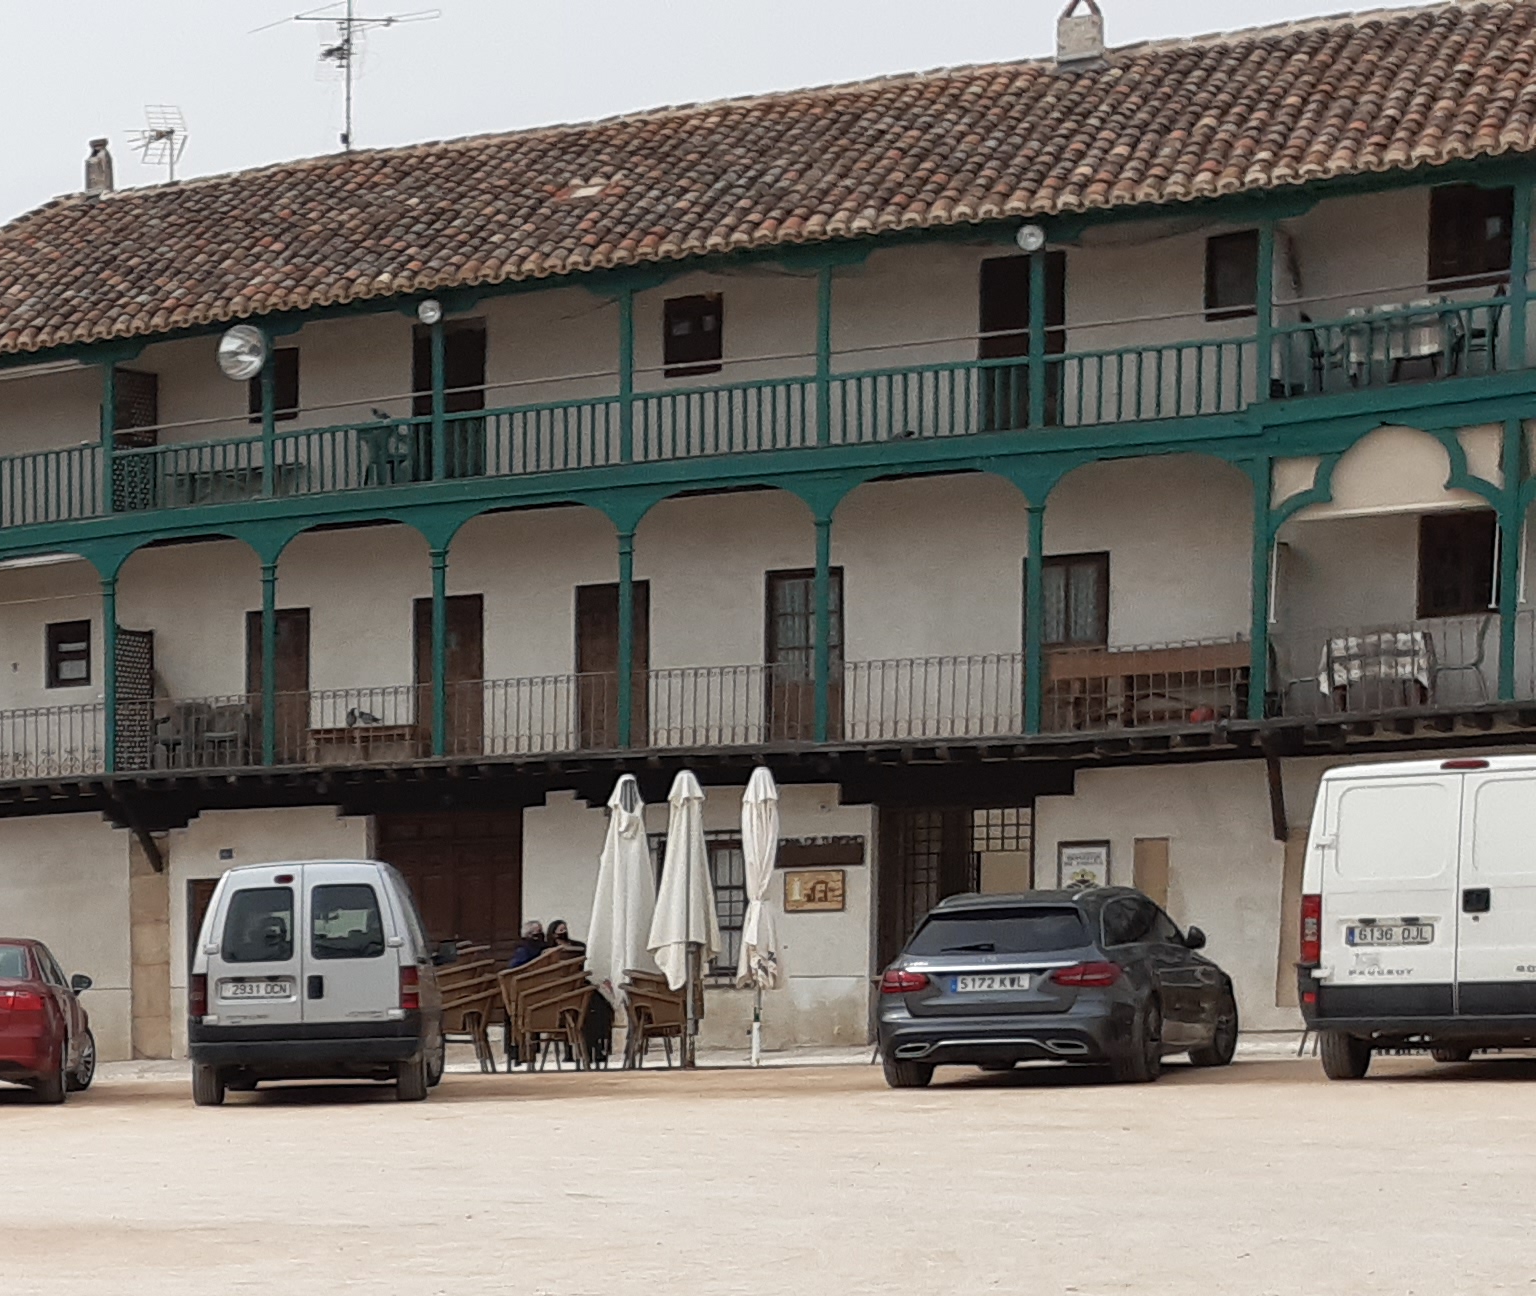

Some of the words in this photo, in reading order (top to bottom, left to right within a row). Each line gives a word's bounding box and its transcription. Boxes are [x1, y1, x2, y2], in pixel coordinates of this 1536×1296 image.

[1359, 927, 1393, 941] 6136
[960, 977, 995, 989] 5172
[232, 984, 260, 995] 2931
